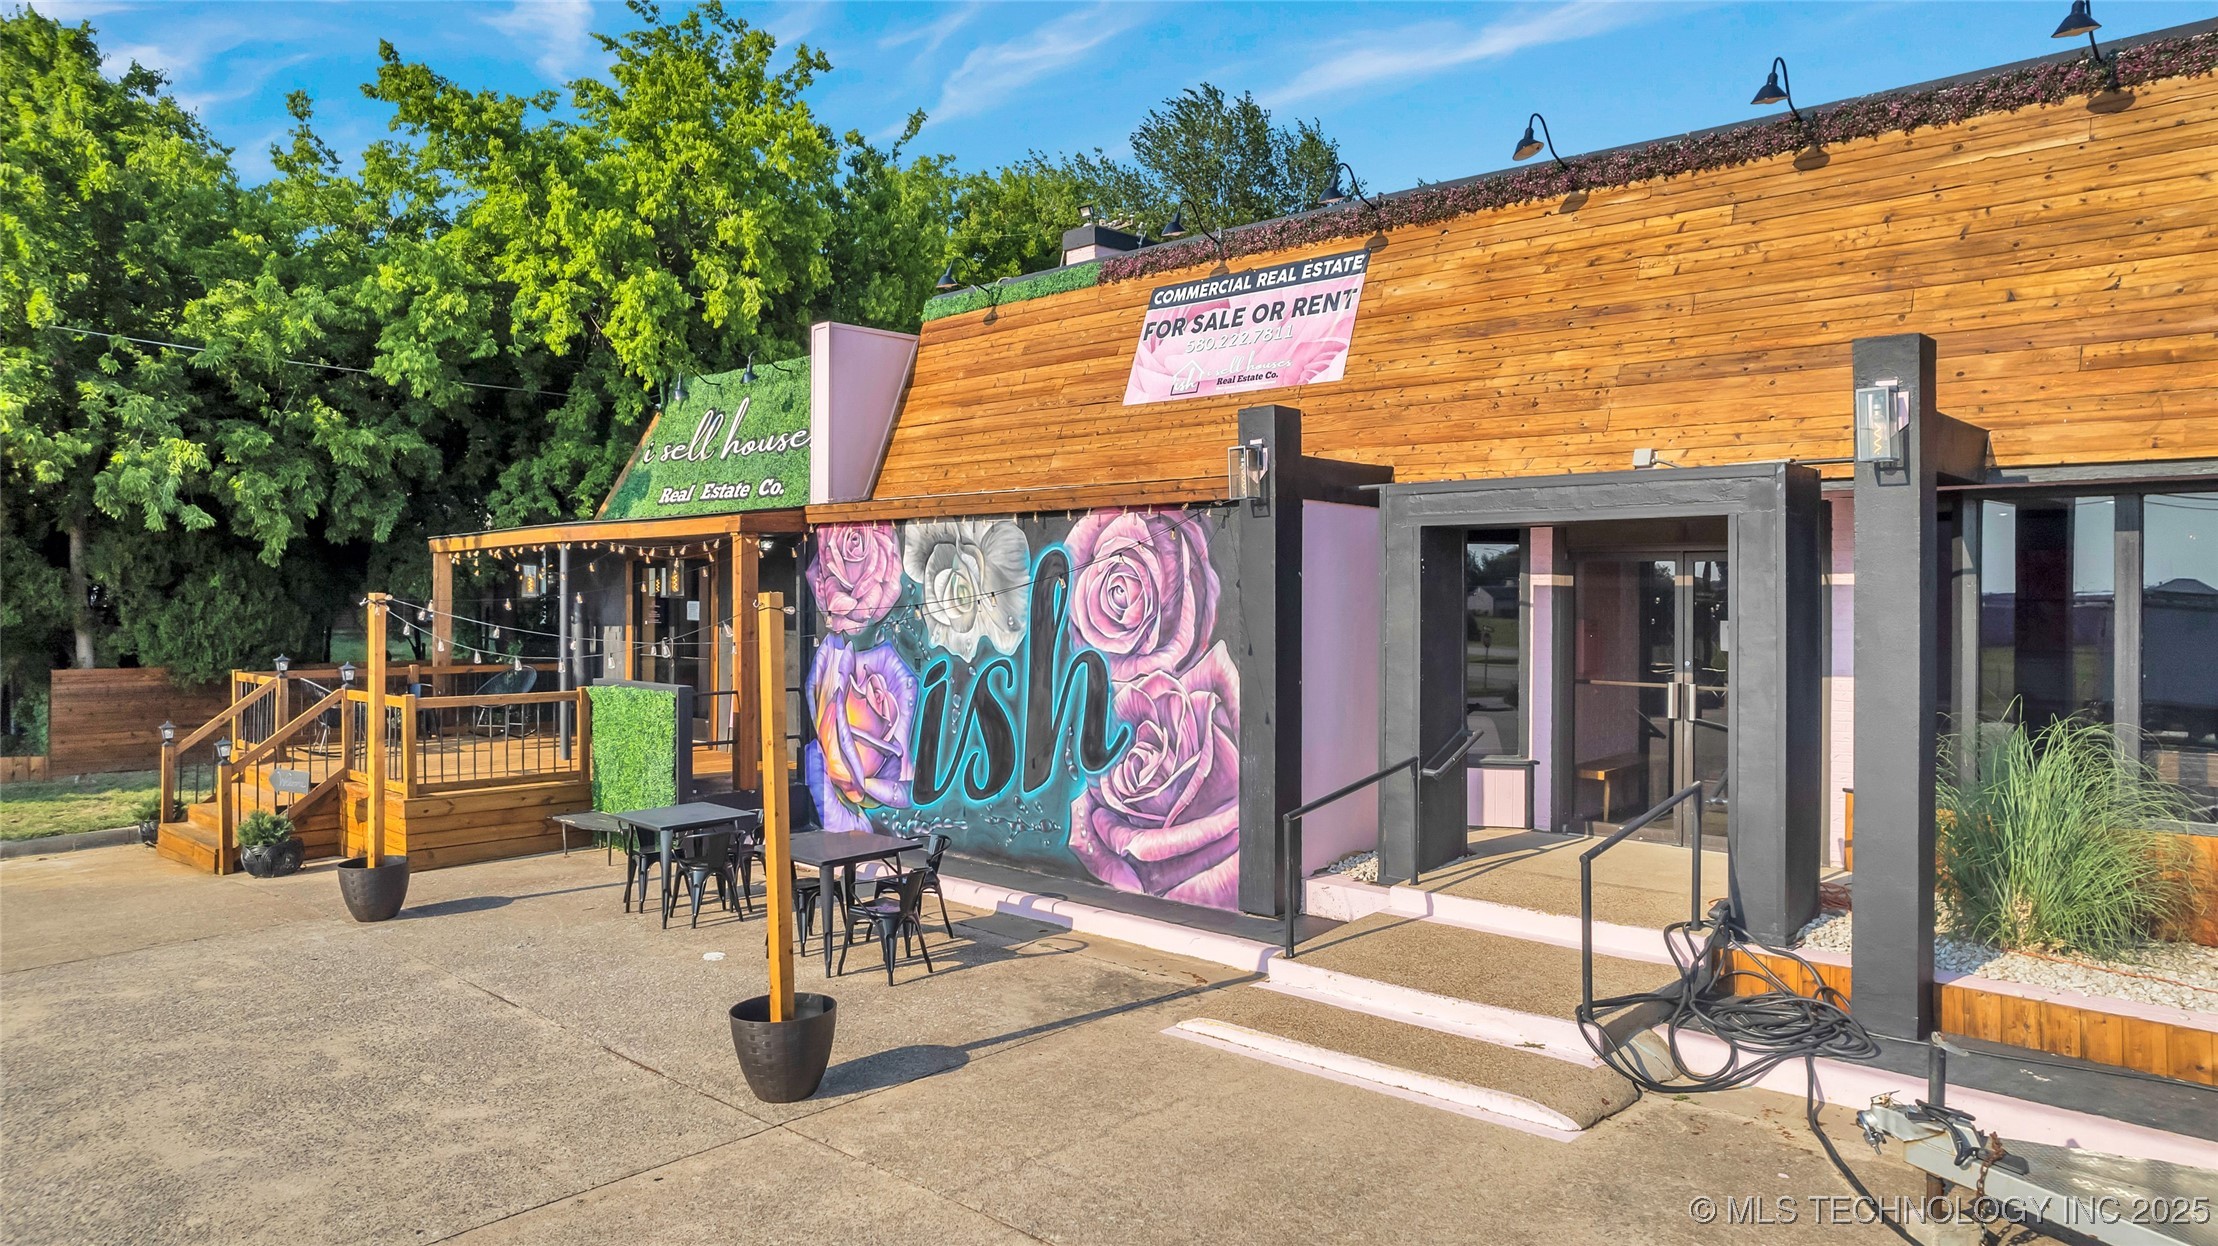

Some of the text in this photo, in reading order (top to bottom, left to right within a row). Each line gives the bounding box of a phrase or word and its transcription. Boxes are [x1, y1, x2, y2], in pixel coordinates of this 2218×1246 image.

[1153, 254, 1366, 305] COMMERCIAL REAL ESTATE
[1143, 288, 1358, 342] FOR SALE OR RENT
[1186, 324, 1294, 354] 580.222.7811
[1216, 375, 1236, 386] Real
[1236, 372, 1264, 383] Estate
[1265, 371, 1279, 379] Co.
[659, 409, 724, 463] sell
[658, 479, 786, 504] Real Estate Co.
[912, 550, 1130, 806] ish
